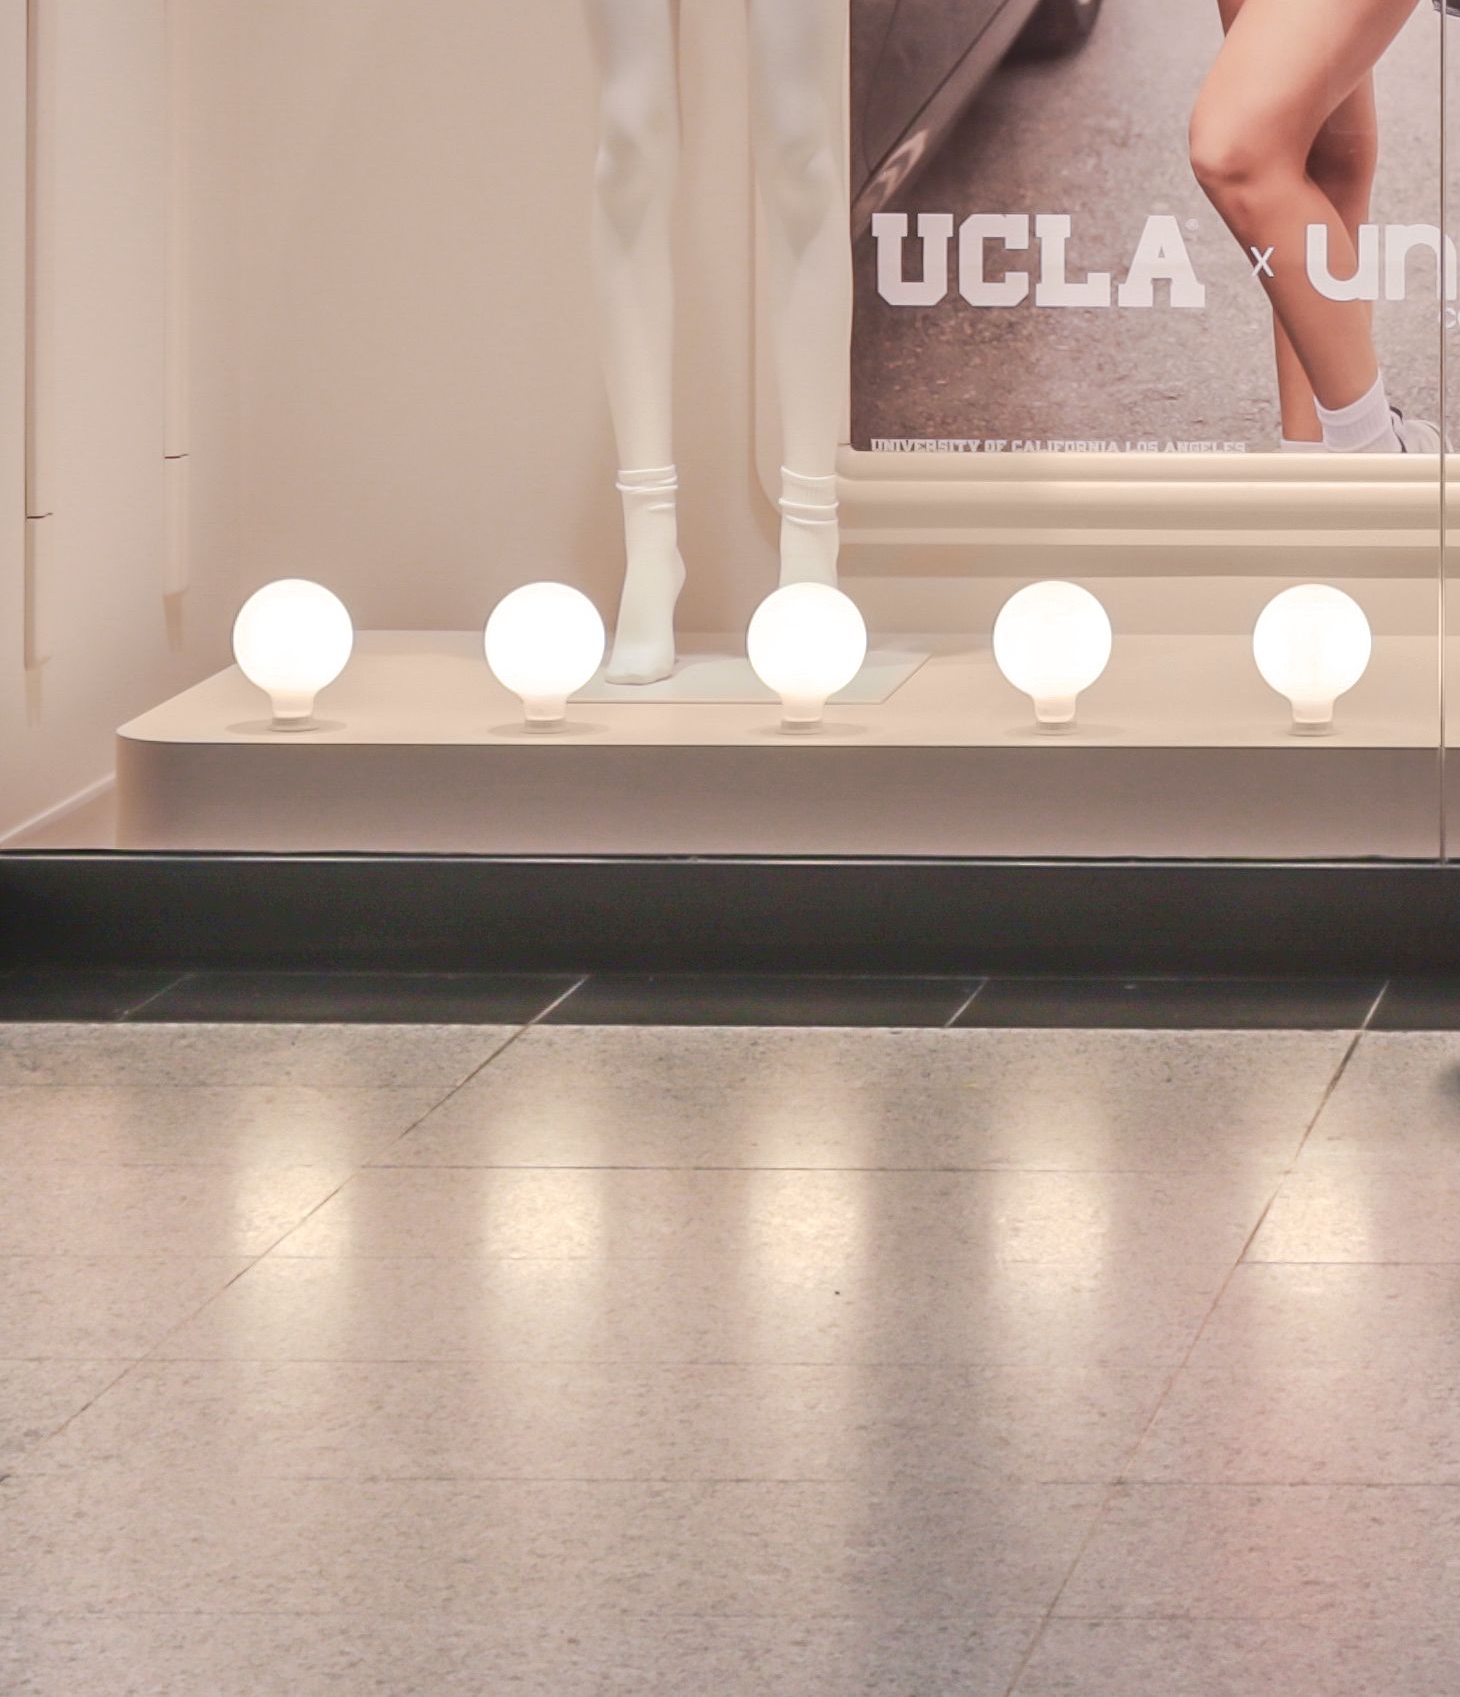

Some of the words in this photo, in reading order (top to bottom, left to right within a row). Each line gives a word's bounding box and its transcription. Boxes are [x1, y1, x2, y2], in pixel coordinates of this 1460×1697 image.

[870, 438, 980, 452] UNIVERSITY
[984, 439, 1008, 452] OF
[1011, 439, 1120, 452] CALIFORNIA
[1125, 440, 1159, 452] LOS
